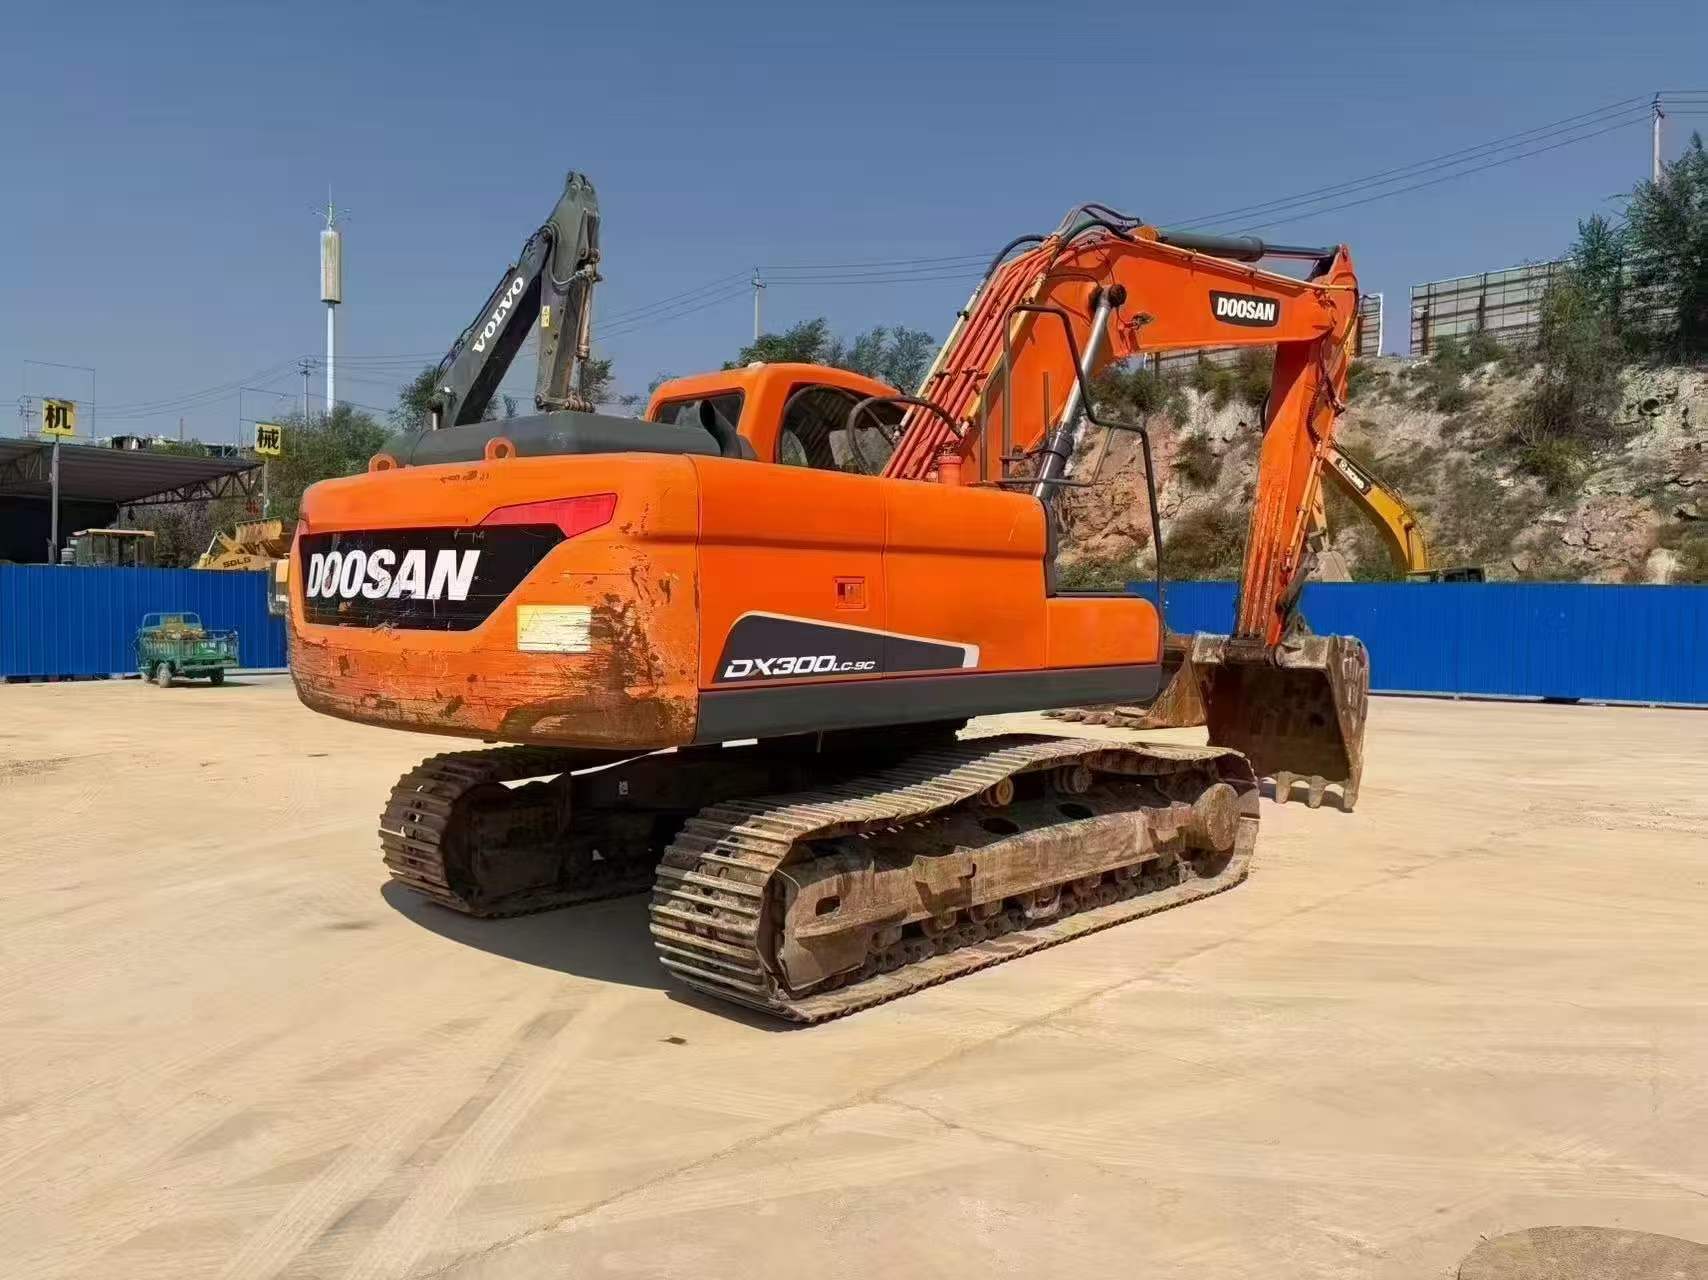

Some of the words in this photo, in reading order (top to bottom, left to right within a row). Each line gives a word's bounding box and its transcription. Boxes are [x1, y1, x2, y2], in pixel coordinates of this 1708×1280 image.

[472, 277, 523, 352] VOLVO
[1217, 297, 1275, 320] DOOSAN
[45, 405, 71, 429] 机
[257, 426, 279, 449] 械
[307, 549, 480, 600] DOOSAN
